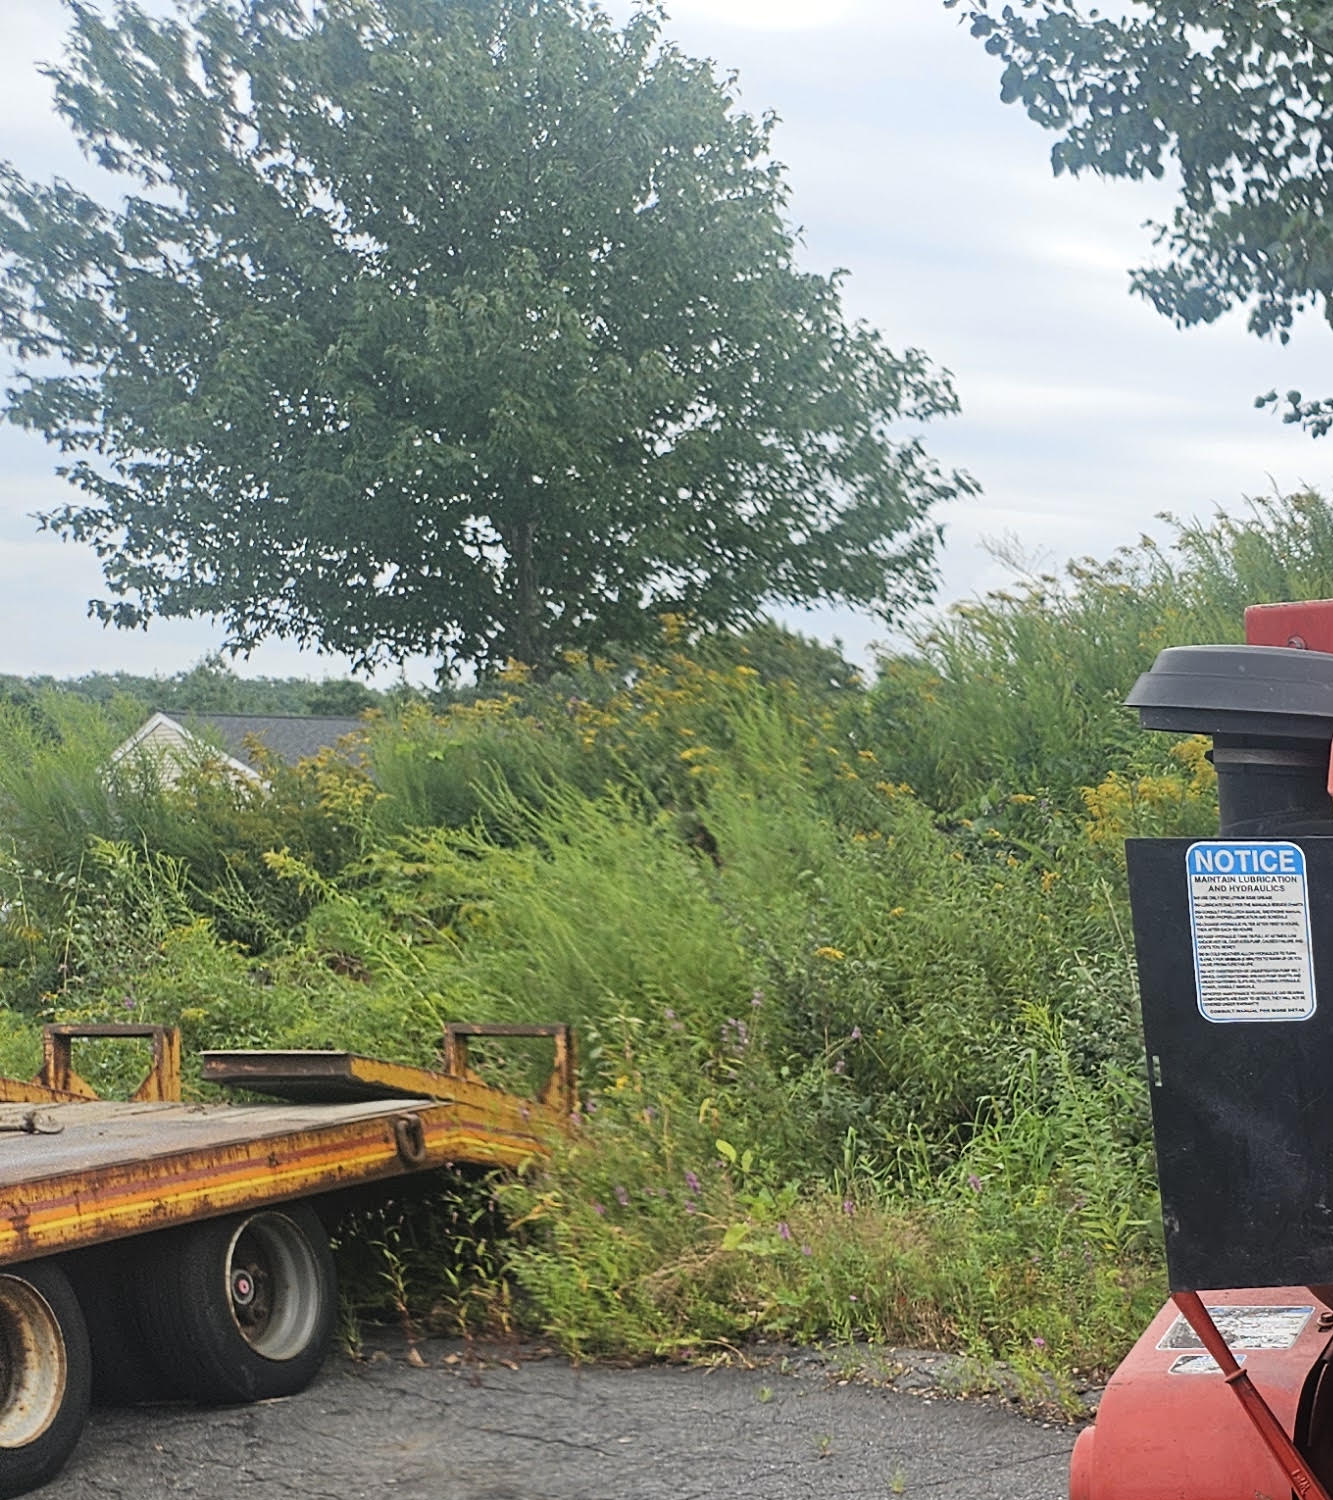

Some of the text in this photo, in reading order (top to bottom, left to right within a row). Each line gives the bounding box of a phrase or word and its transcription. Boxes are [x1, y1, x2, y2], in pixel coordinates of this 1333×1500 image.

[1194, 849, 1296, 873] NOTICE
[1194, 875, 1297, 883] MAINTAIN LUBRICATION
[1229, 884, 1286, 892] HYDRAULICS
